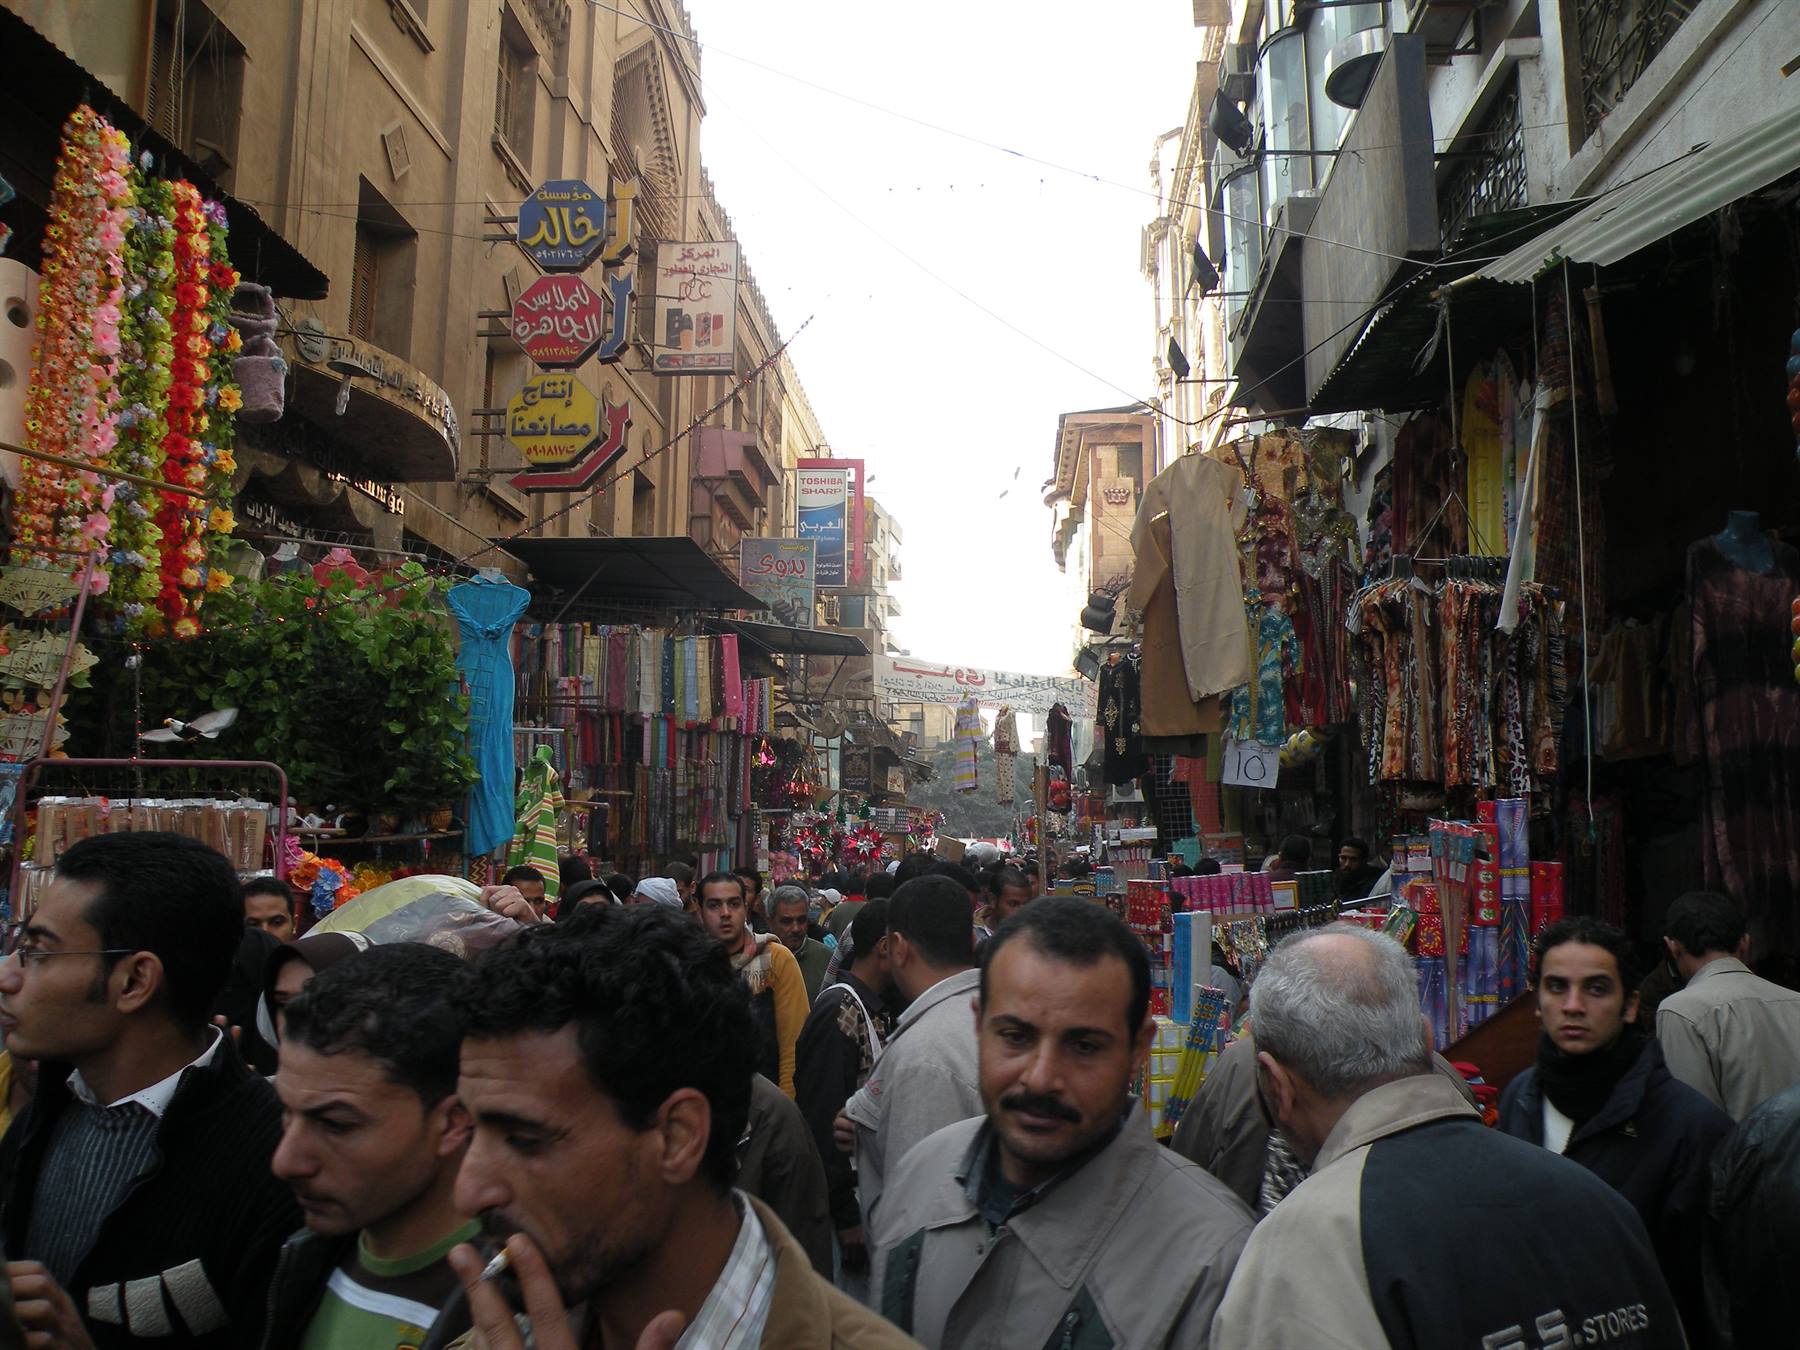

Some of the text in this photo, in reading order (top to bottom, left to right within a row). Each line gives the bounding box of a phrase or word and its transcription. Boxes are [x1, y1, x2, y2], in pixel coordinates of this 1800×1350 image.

[537, 185, 592, 201] مؤسسة
[521, 206, 600, 247] خالد
[677, 247, 720, 261] المركز
[517, 284, 590, 312] للملابس
[514, 313, 600, 345] الجاهزة
[522, 380, 574, 408] إنتاج
[511, 414, 592, 437] مصانعنا
[800, 477, 843, 485] TOSHIBA
[747, 553, 807, 578] بدوى
[1237, 751, 1266, 781] 10
[1582, 1303, 1649, 1345] STORES
